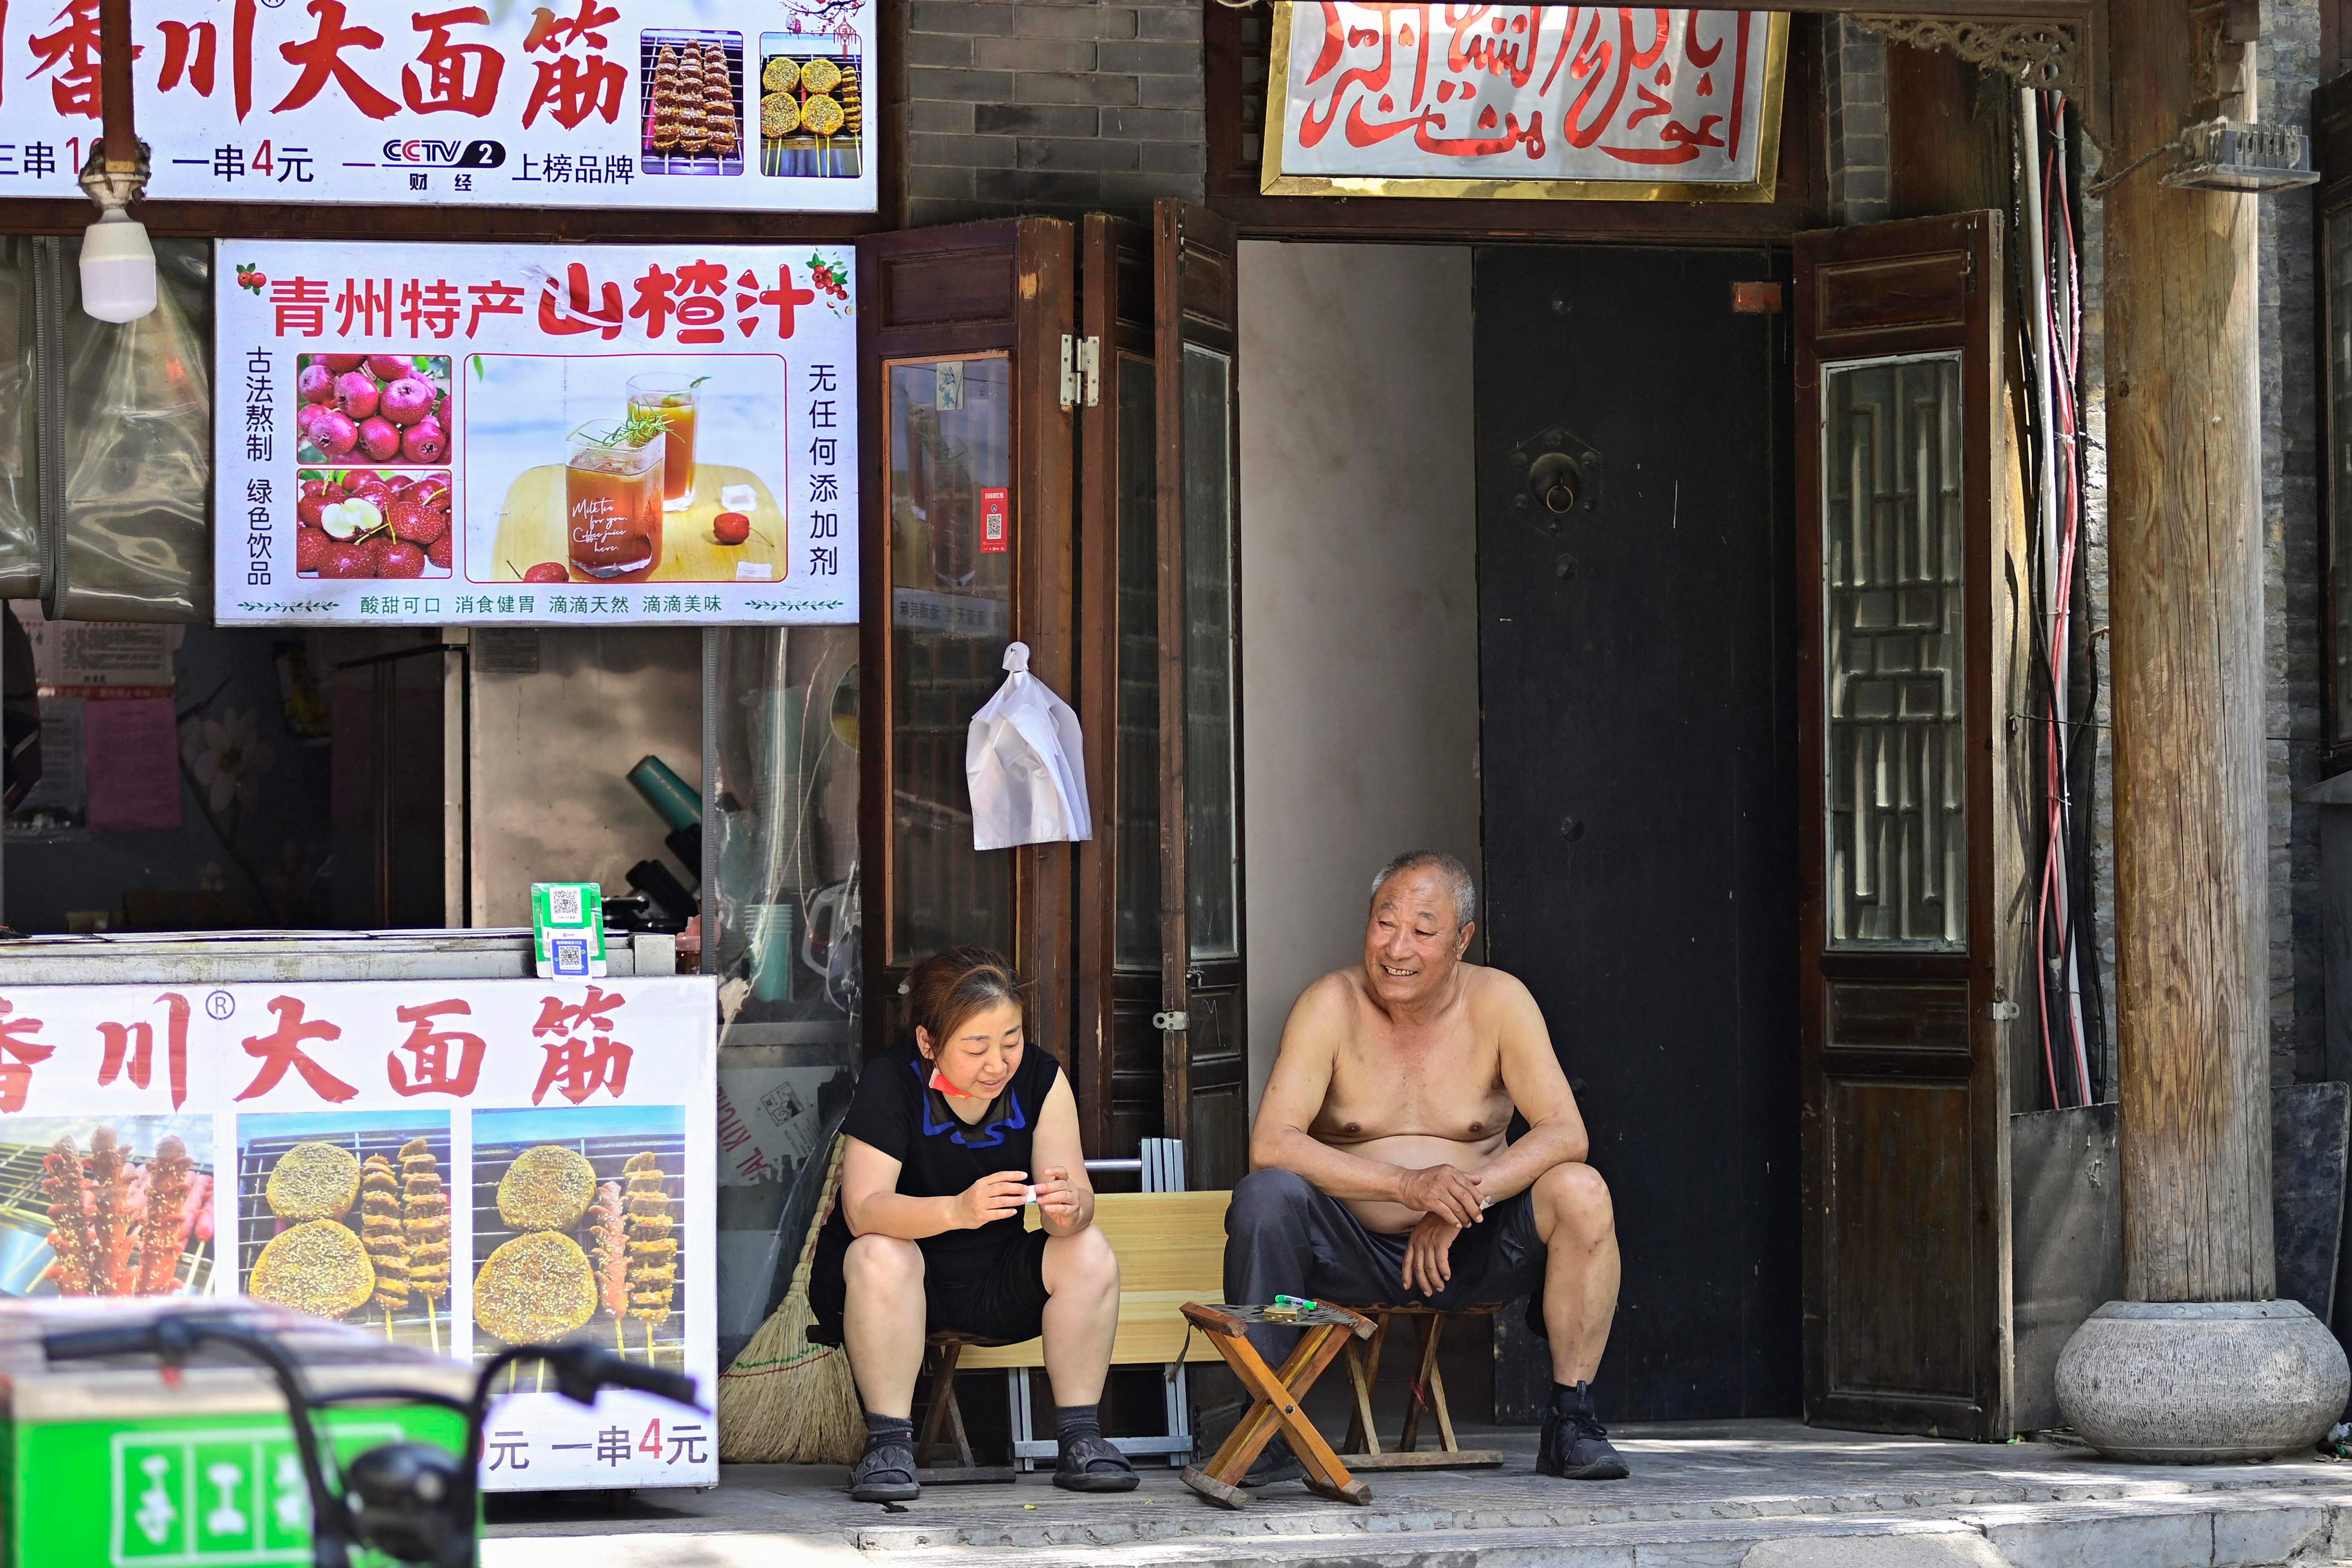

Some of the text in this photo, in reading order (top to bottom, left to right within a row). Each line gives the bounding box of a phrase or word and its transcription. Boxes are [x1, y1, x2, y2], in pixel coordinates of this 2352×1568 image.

[0, 137, 313, 182] 三串1 一串4元
[383, 140, 461, 162] CCTV
[512, 153, 634, 184] 上榜品牌
[410, 174, 471, 191] 财经
[270, 259, 815, 344] 青州特产 山楂汁
[246, 346, 273, 585] 古法熬制 绿色饮品
[809, 365, 838, 576] 无任何添加剂
[361, 594, 722, 614] 酸甜可口 消食健胃 滴滴天然 滴滴美味
[552, 1418, 708, 1467] 一串4元
